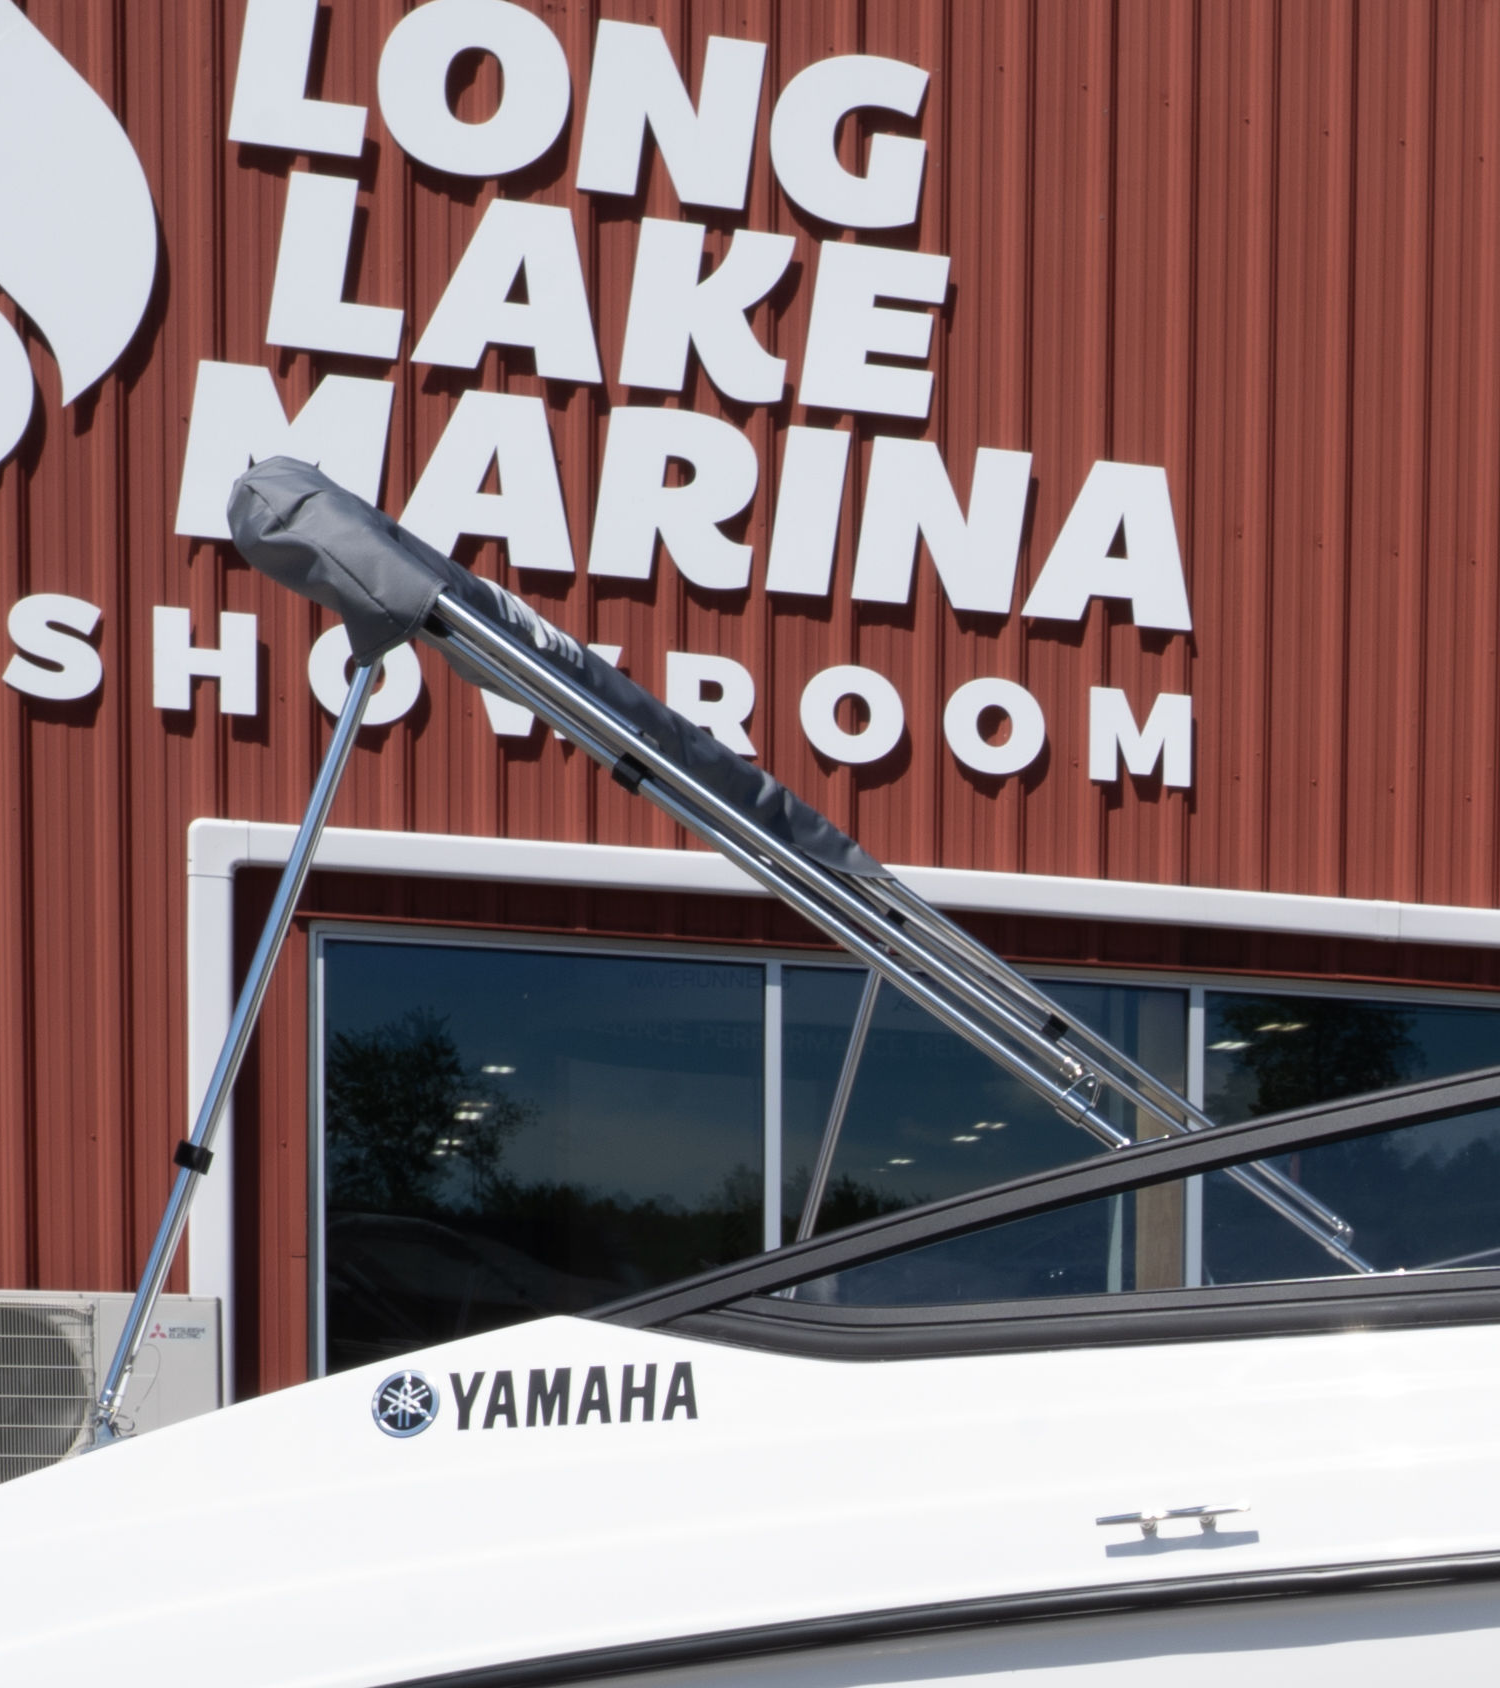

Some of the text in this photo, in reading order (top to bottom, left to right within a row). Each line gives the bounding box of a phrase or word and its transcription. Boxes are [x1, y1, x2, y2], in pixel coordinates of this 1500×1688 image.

[228, 0, 929, 229] LONG
[266, 172, 949, 419] LAKE
[174, 359, 1193, 632] MARINA
[627, 969, 790, 990] WAVERUNNES
[449, 1361, 698, 1430] YAMAHA
